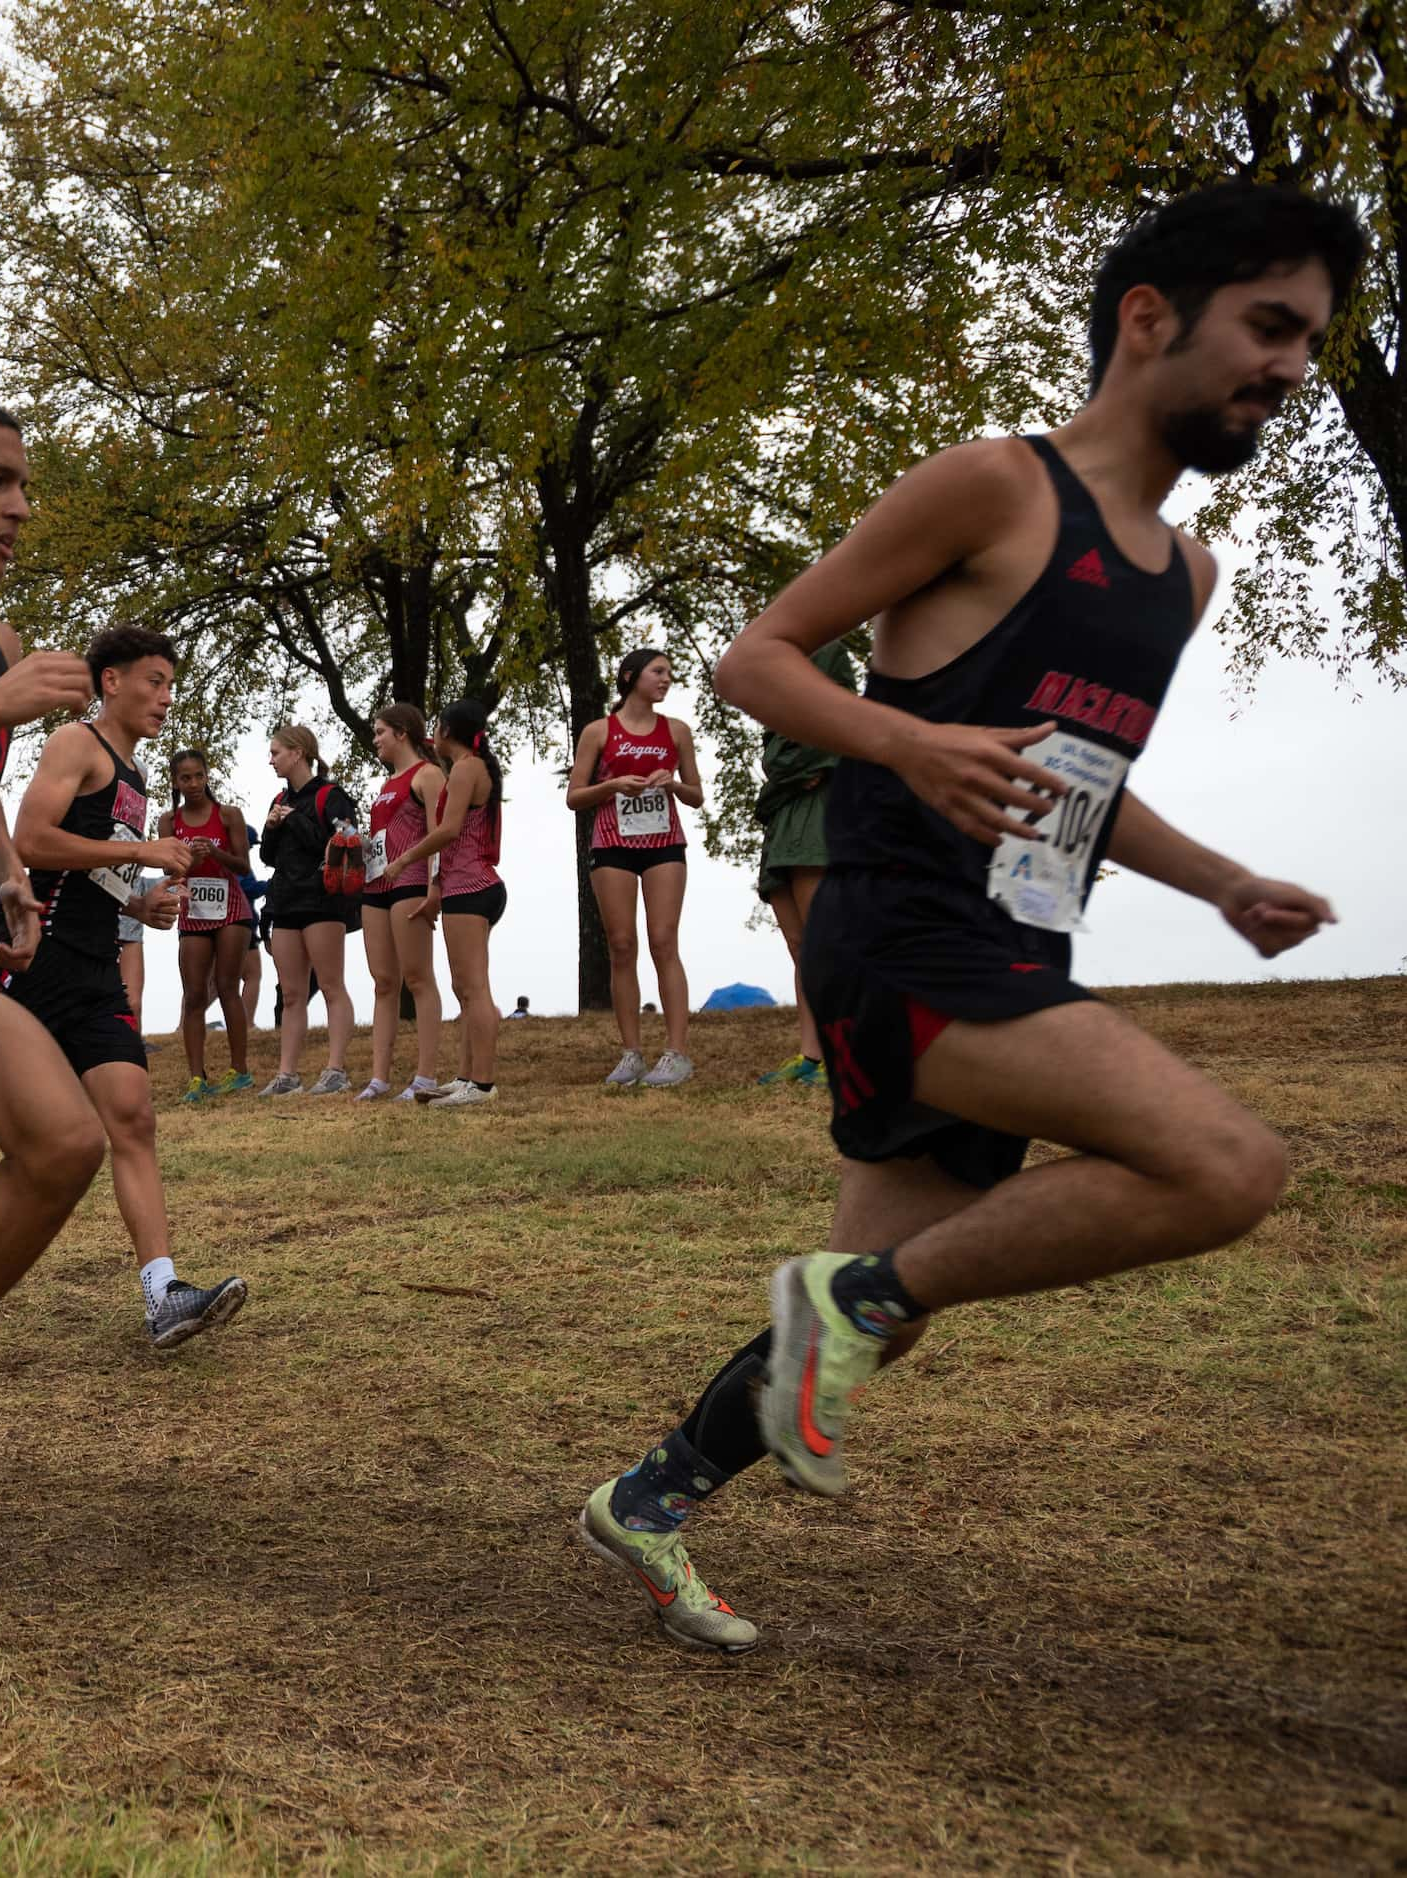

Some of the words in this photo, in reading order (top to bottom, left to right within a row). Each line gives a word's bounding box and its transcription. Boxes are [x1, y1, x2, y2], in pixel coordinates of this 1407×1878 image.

[615, 742, 668, 760] Legacy
[621, 794, 665, 815] 2058
[190, 887, 225, 902] 2060
